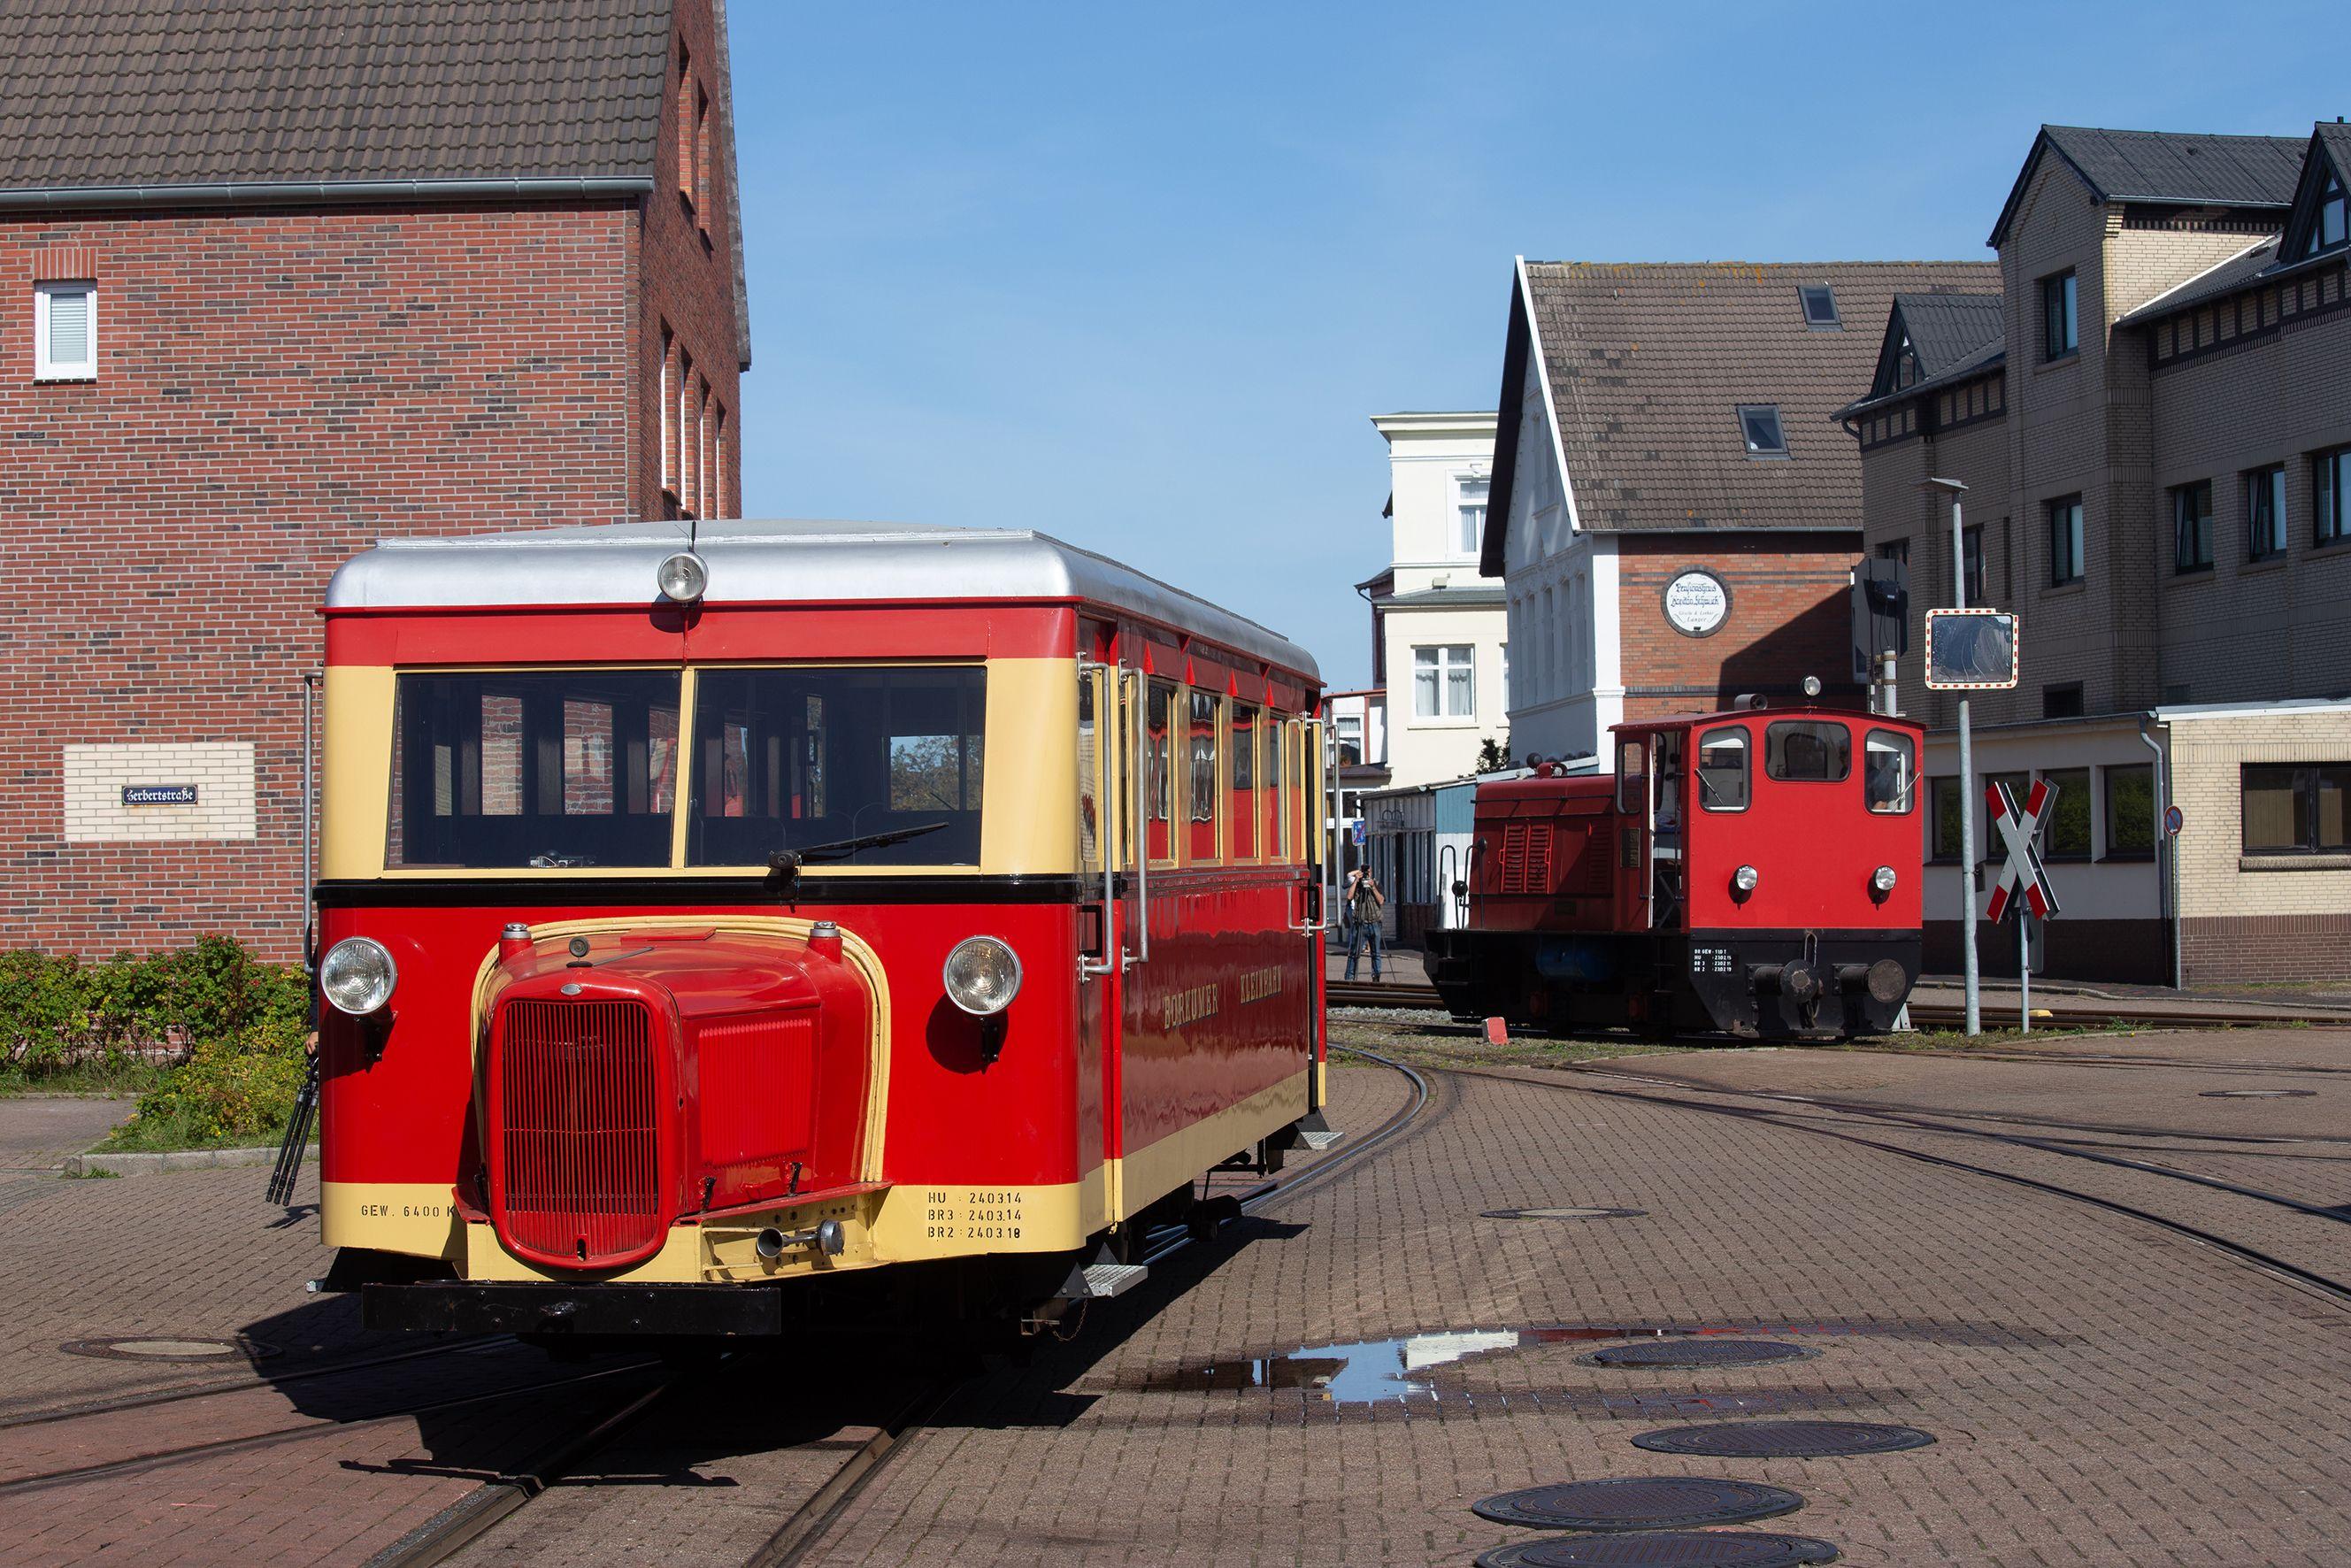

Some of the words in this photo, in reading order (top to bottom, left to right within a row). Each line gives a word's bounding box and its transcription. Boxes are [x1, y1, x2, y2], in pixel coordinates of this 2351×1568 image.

[1163, 983, 1218, 1029] BORKUMER
[1240, 965, 1282, 1003] KLEINBAHN
[928, 1192, 946, 1203] HU
[361, 1204, 395, 1217] GEW.
[403, 1205, 440, 1218] 6400
